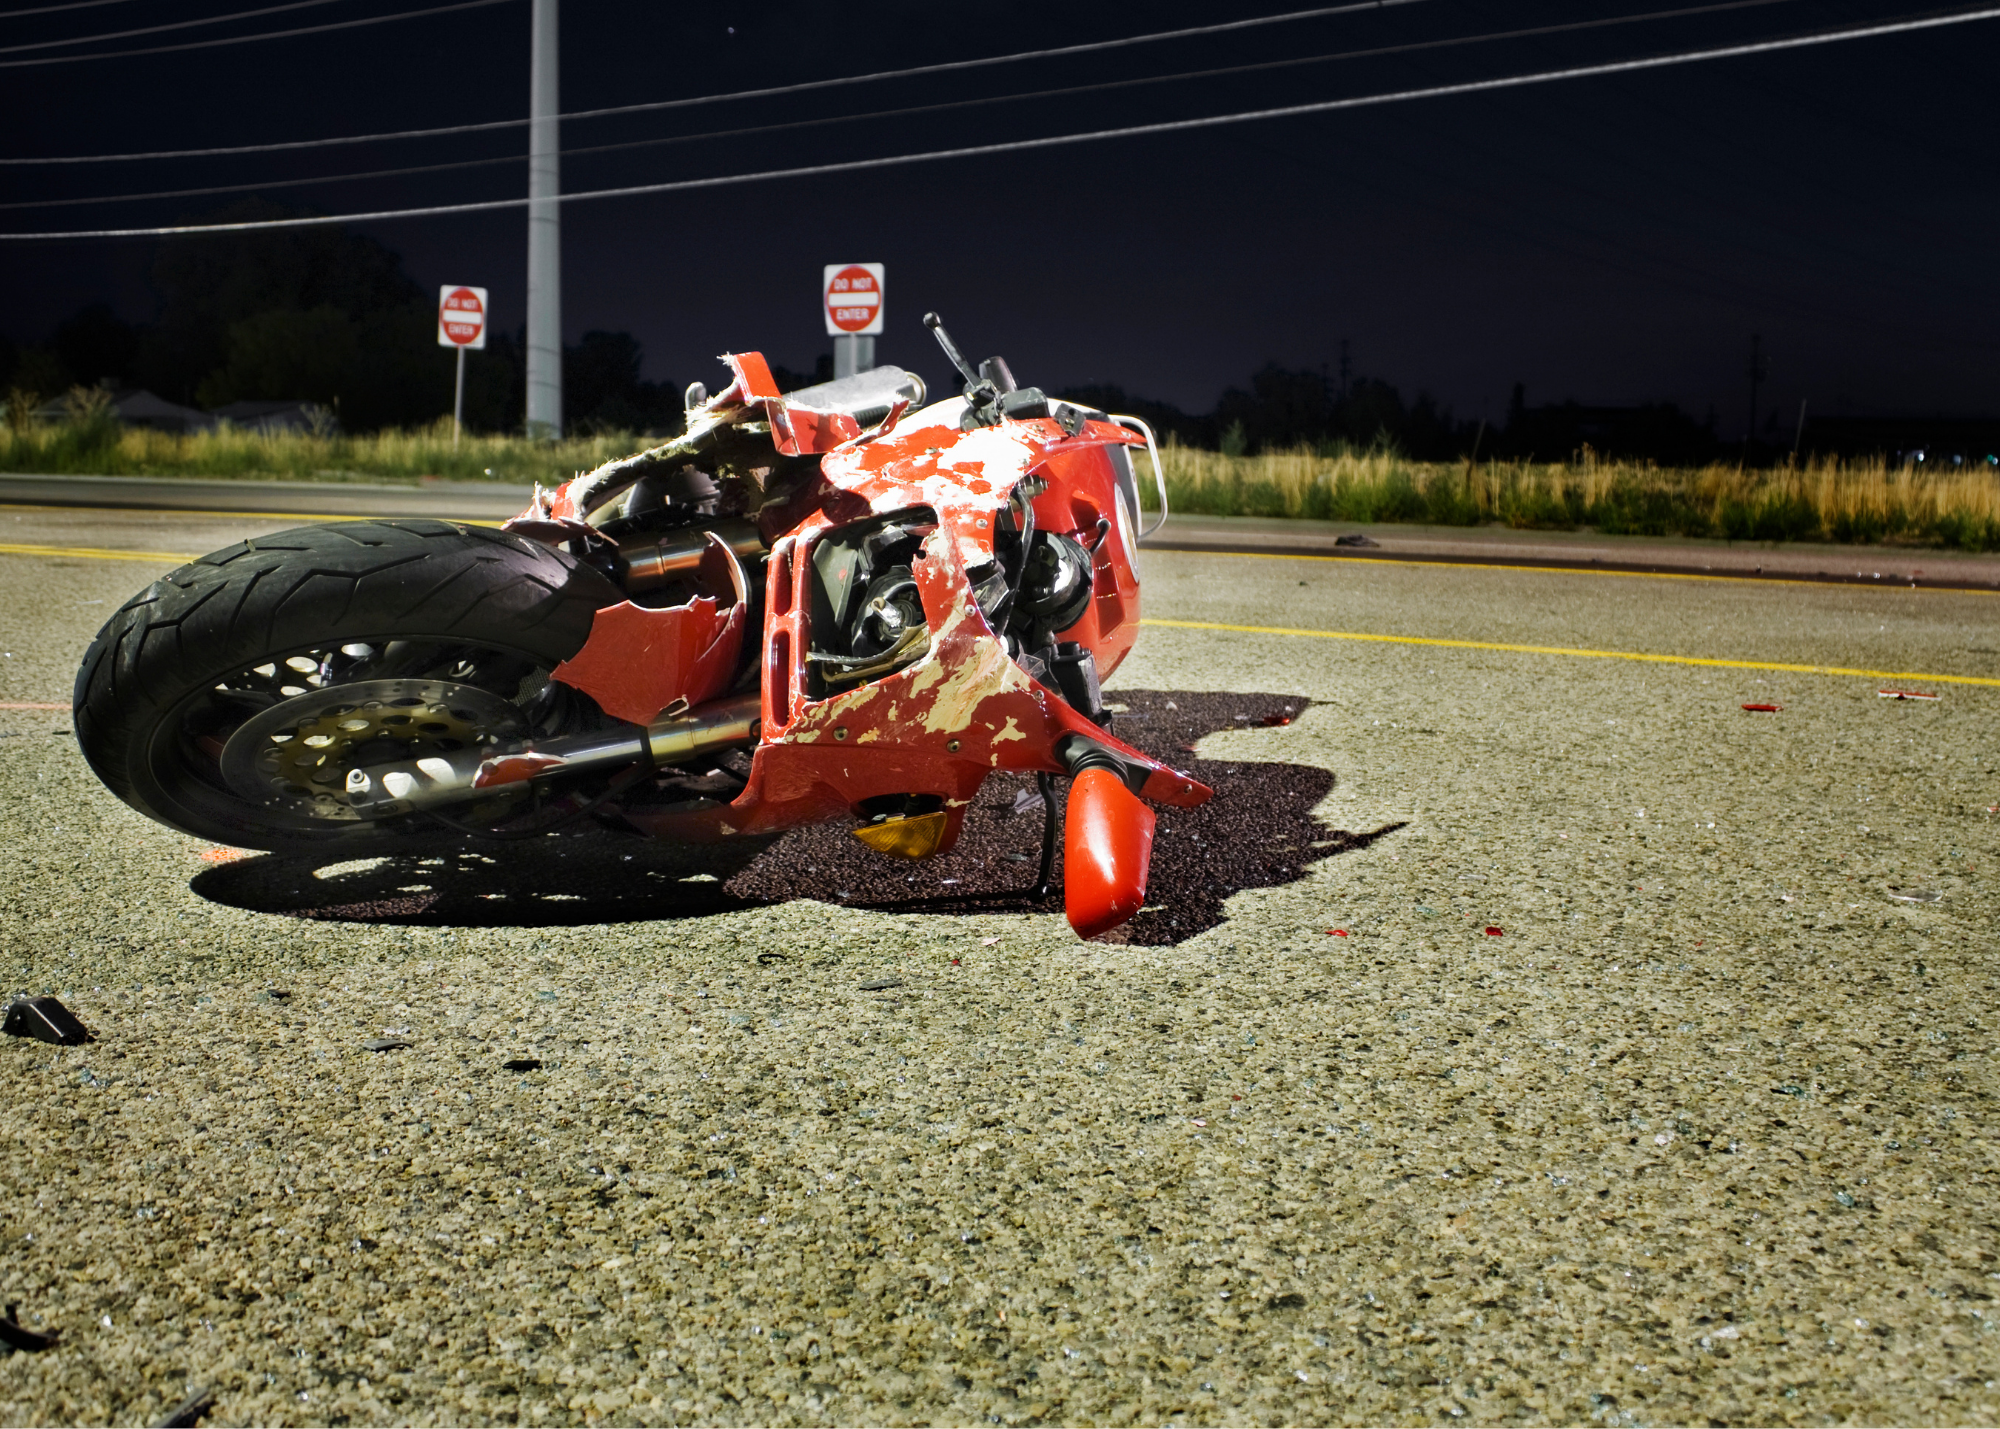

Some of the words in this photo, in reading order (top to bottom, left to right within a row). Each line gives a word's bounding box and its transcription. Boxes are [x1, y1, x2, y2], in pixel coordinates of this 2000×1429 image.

[834, 278, 849, 290] DO
[852, 277, 872, 290] NOT
[461, 299, 478, 310] NOT
[836, 308, 870, 321] ENTER
[448, 323, 474, 336] ENTER
